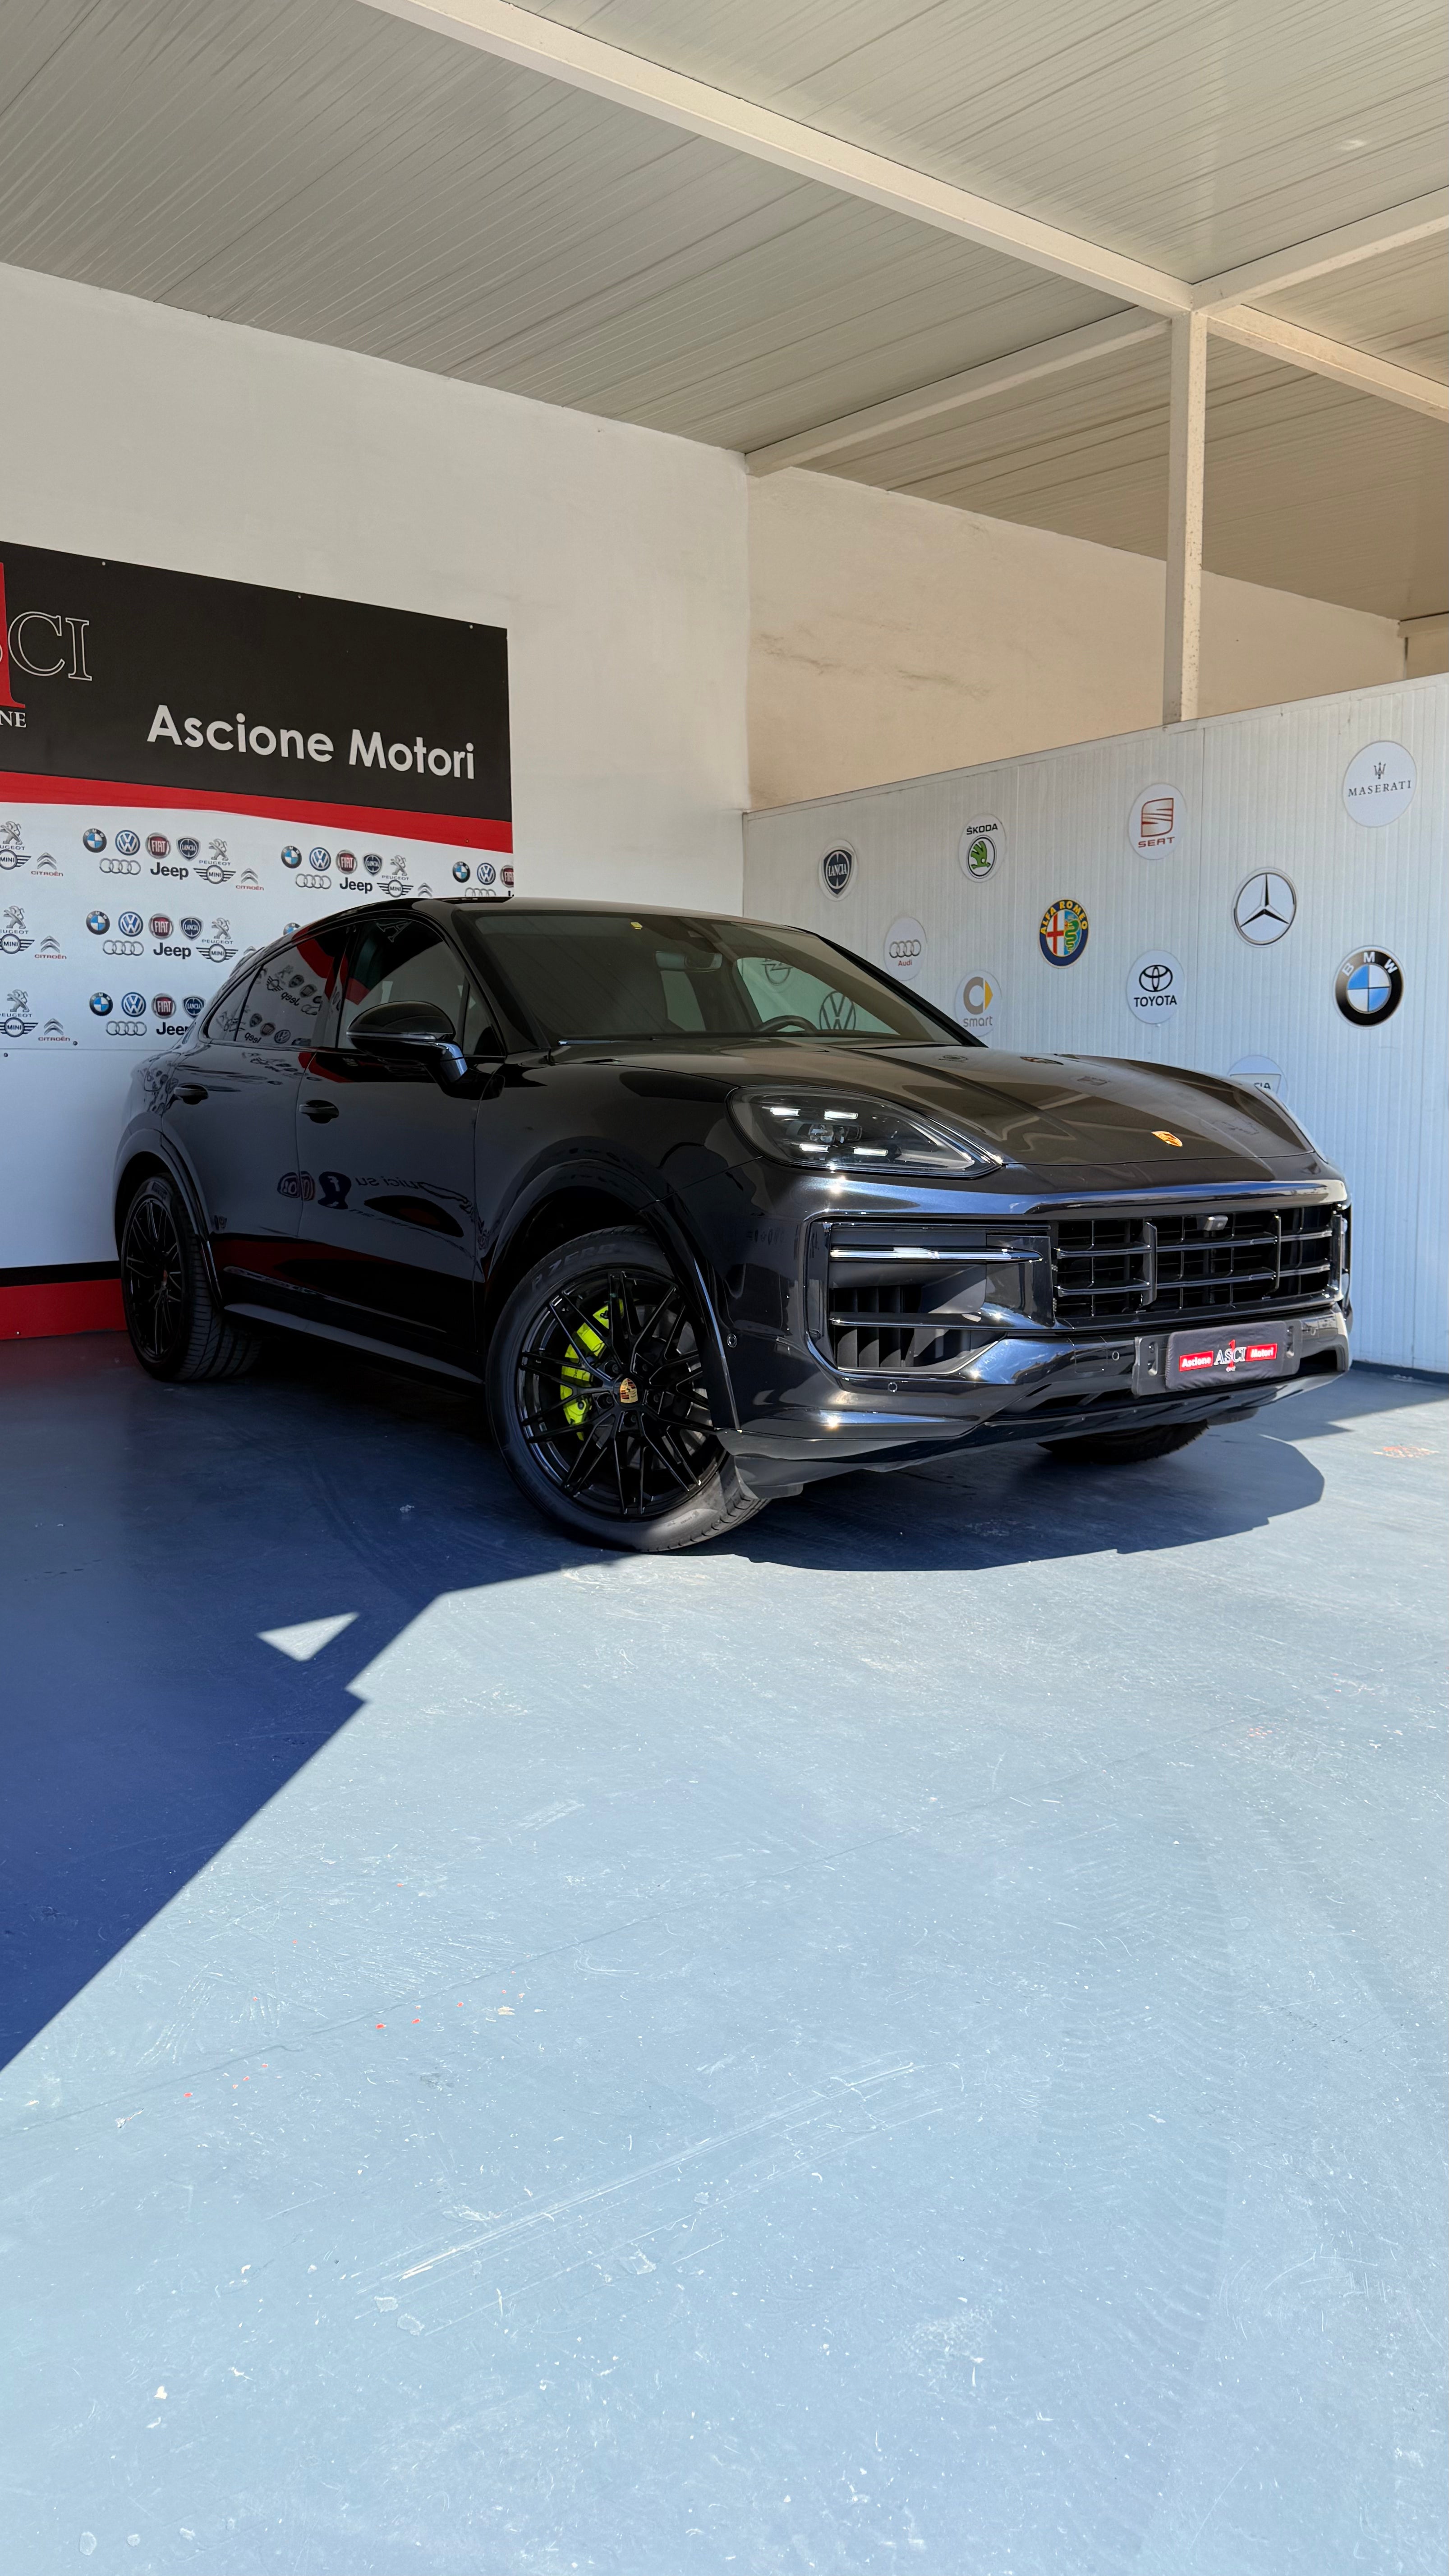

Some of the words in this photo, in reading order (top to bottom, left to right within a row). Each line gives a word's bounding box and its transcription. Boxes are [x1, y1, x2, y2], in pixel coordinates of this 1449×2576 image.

[0, 611, 92, 681] CI
[147, 704, 334, 762] Ascione
[349, 728, 474, 779] Motori
[1348, 780, 1412, 797] MASERATI
[966, 823, 998, 835] ŠKODA
[151, 840, 166, 853] FIAT
[181, 844, 196, 852] LANCIA
[1138, 837, 1175, 848] SEAT
[340, 857, 354, 868] FIAT
[150, 862, 189, 880] Jeep
[828, 863, 847, 877] LANCIA
[339, 877, 373, 894] Jeep
[1040, 907, 1057, 935] ALFA
[1059, 901, 1088, 930] ROMEO
[154, 921, 169, 933] FIAT
[153, 942, 192, 959] Jeep
[1342, 952, 1398, 976] BMW
[157, 1000, 171, 1013] FIAT
[1133, 994, 1177, 1007] TOYOTA
[963, 1016, 993, 1027] smart
[1182, 1357, 1212, 1368] Ascione
[1251, 1347, 1274, 1358] Motori
